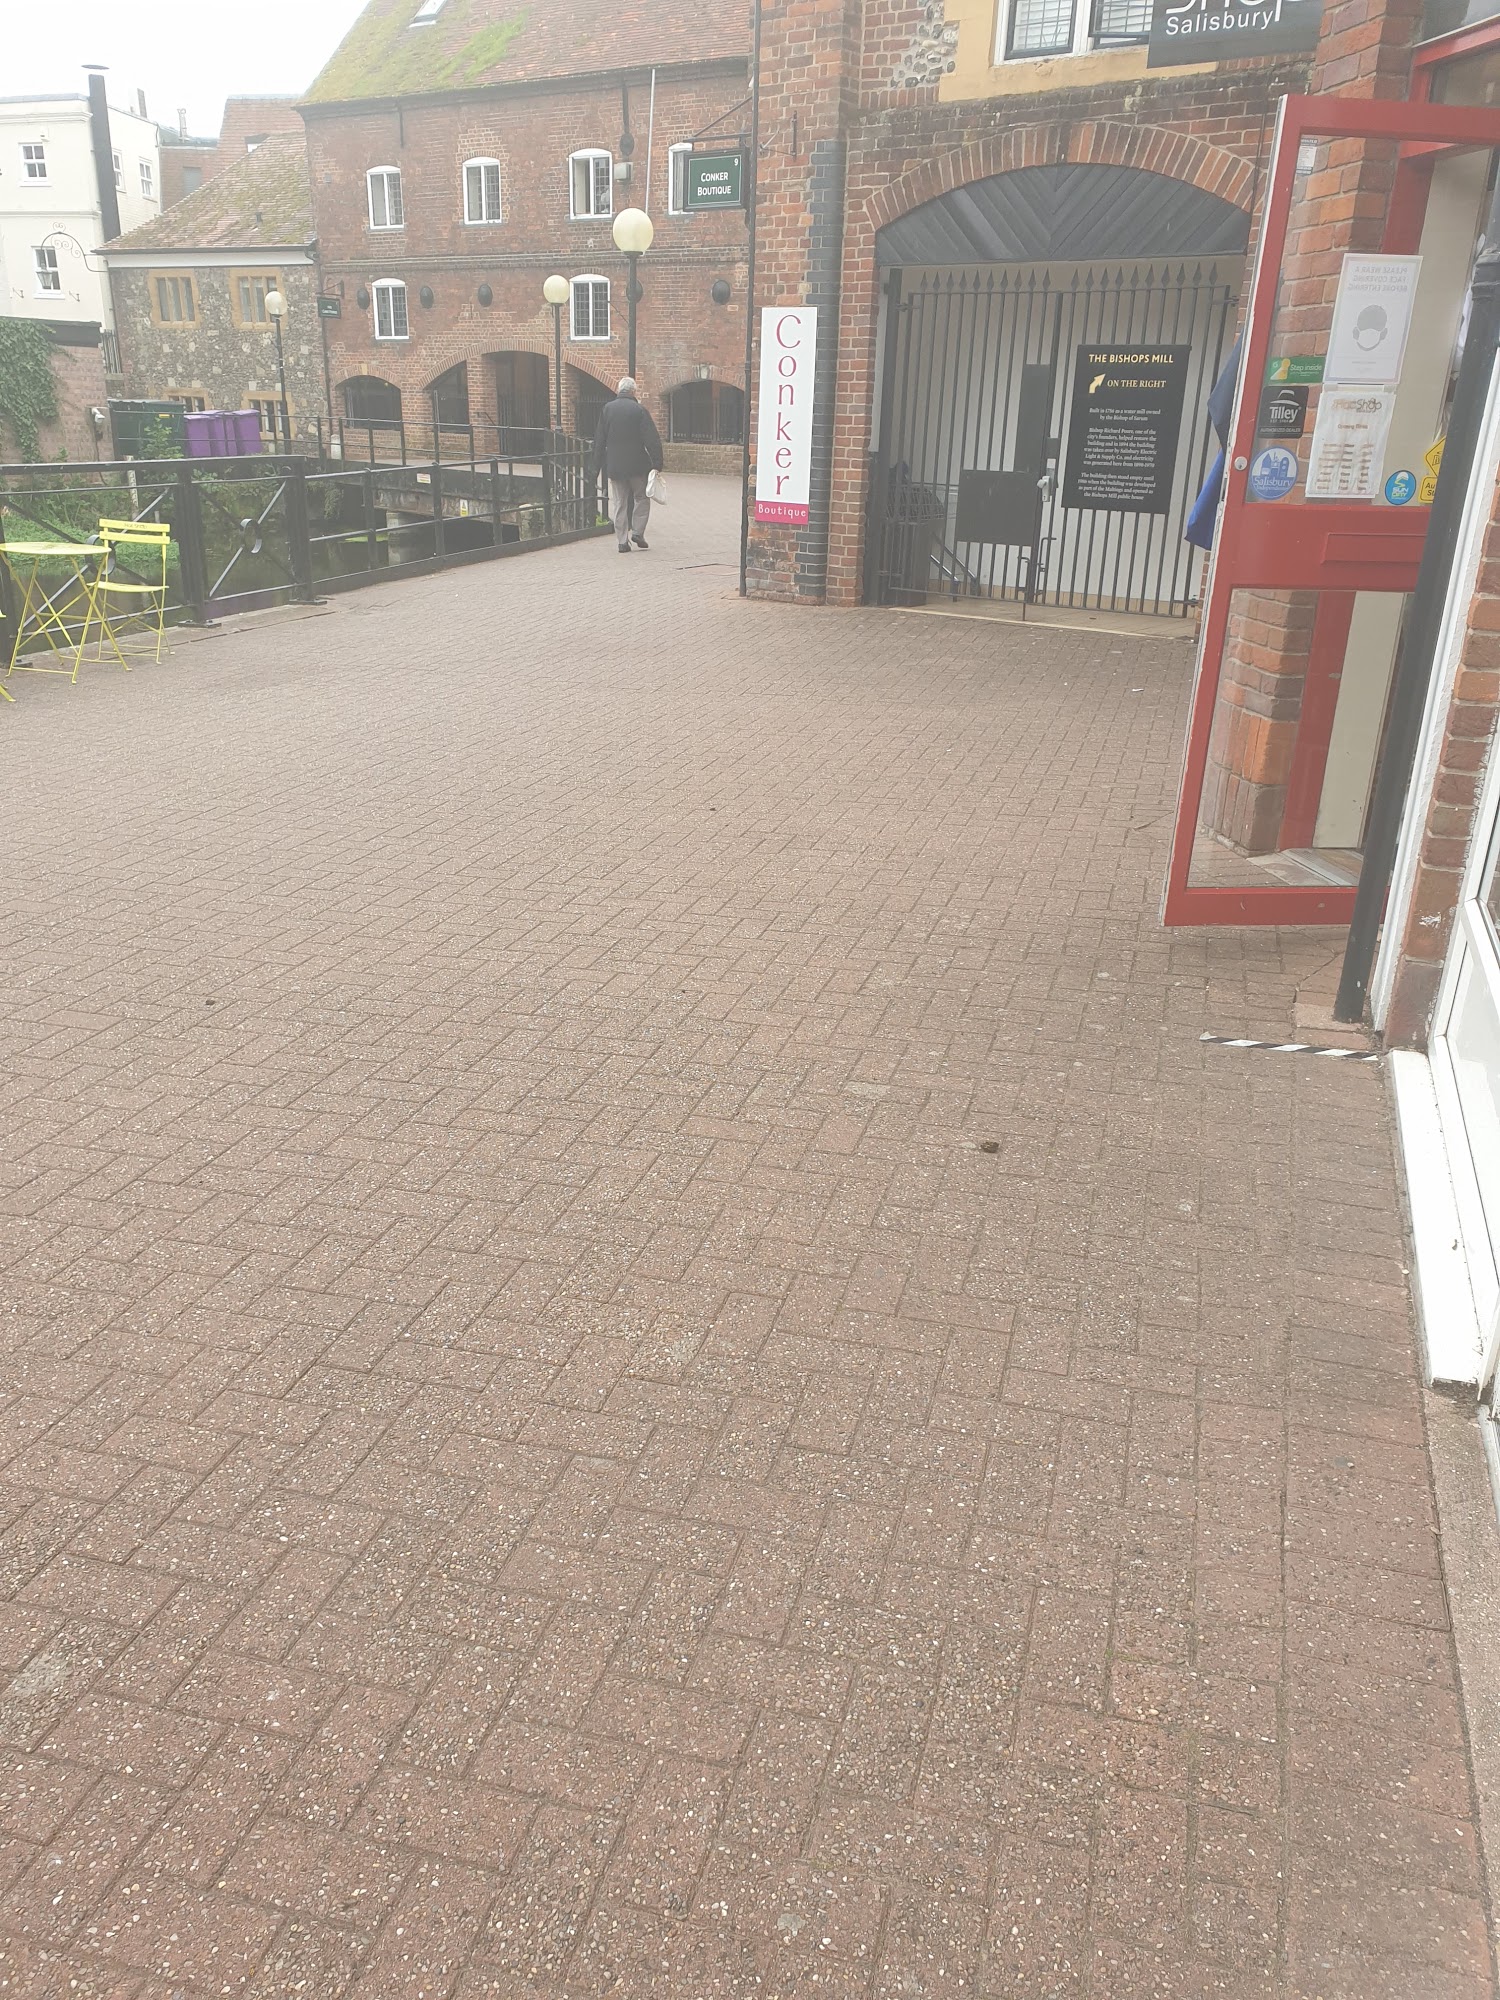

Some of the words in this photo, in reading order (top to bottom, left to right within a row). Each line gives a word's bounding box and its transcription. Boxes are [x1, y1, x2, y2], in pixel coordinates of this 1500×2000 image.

[1166, 10, 1274, 36] Salisbury
[734, 158, 738, 166] 9
[700, 172, 728, 182] CONKER
[698, 186, 732, 196] BOUTIQUE
[1089, 354, 1107, 363] THE
[1110, 354, 1150, 364] BISHOPS
[1152, 354, 1174, 364] MILL
[1290, 364, 1304, 372] Step
[1107, 379, 1120, 388] ON
[1120, 380, 1138, 388] THE
[1139, 380, 1166, 388] RIGHT
[776, 314, 802, 495] Conker
[1269, 406, 1298, 424] Tilley
[1254, 476, 1292, 488] Salisbury
[758, 504, 806, 518] Boutique
